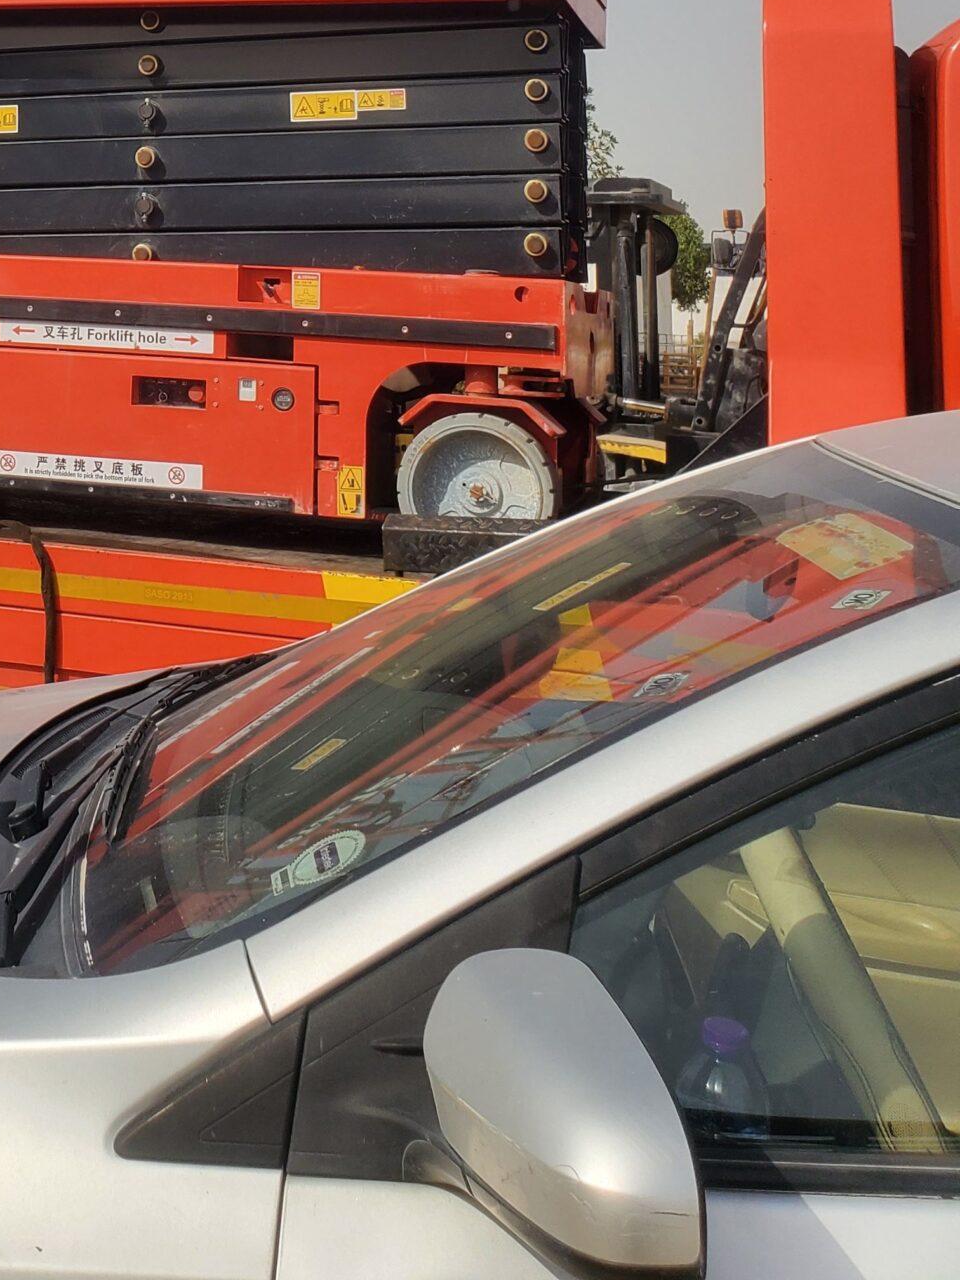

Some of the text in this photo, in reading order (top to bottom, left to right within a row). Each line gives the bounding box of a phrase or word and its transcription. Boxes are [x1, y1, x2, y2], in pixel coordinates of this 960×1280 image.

[43, 325, 167, 344] 叉车孔 Forklift hole
[36, 456, 143, 476] 严禁挑叉底板
[35, 468, 51, 476] strictly
[52, 469, 76, 477] forbidden
[124, 475, 137, 483] plate
[144, 587, 170, 600] SASO
